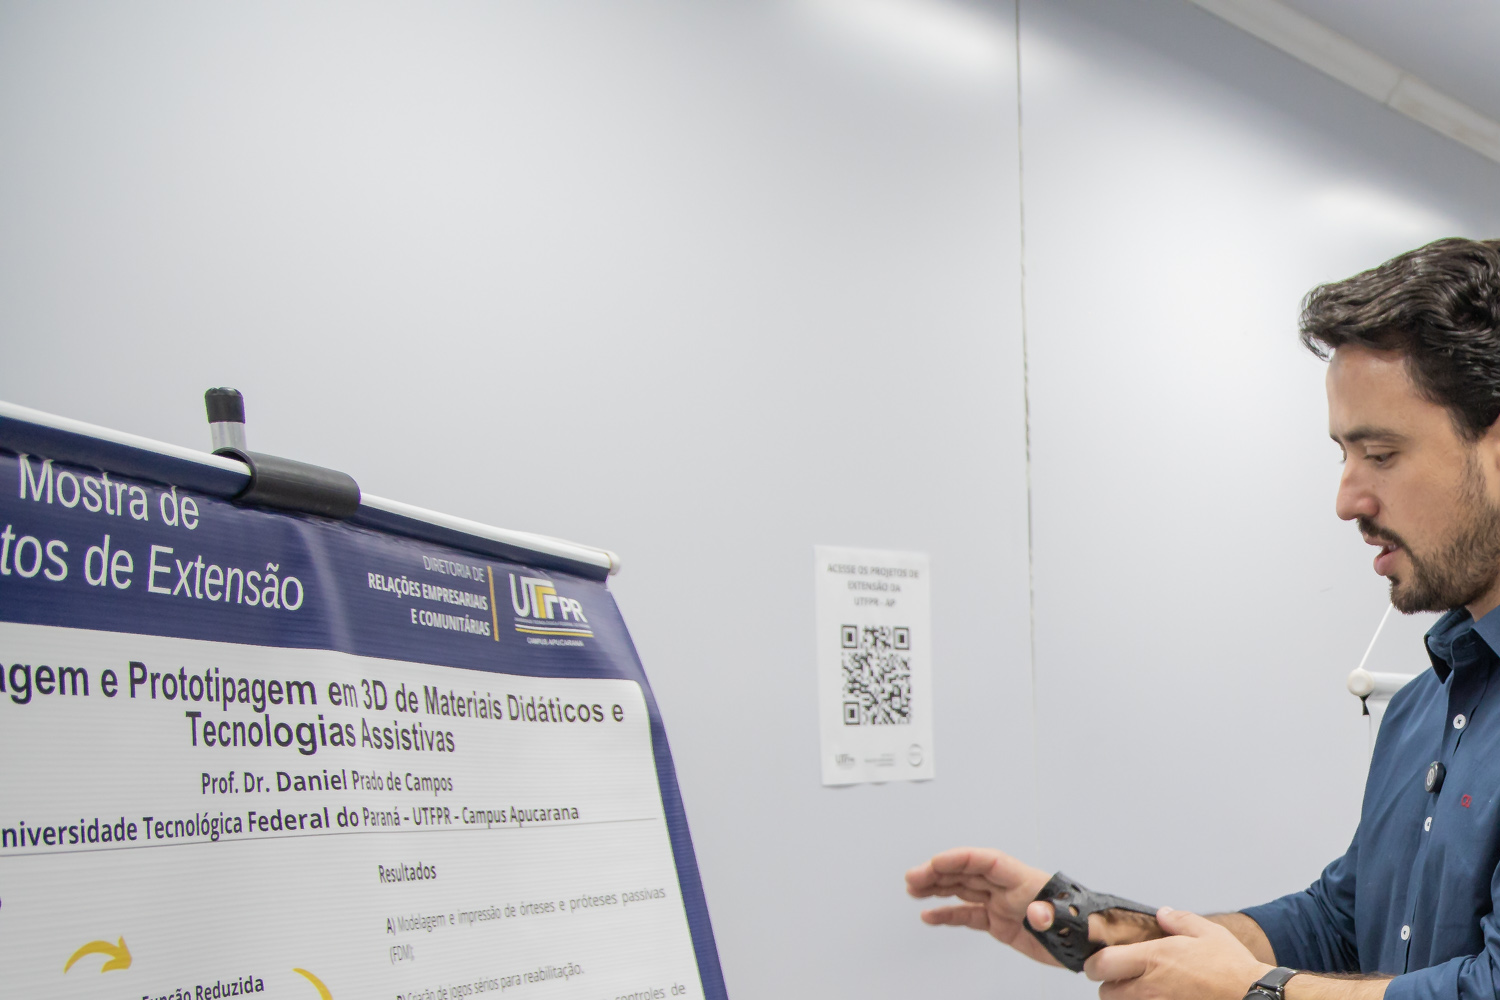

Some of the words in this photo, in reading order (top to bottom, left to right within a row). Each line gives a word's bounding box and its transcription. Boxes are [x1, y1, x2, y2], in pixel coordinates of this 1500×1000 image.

[19, 453, 149, 522] Mostra
[160, 485, 200, 530] de
[84, 534, 134, 590] de
[147, 544, 304, 611] Extensão
[423, 555, 473, 580] DIRETORIA
[472, 566, 486, 583] DE
[827, 563, 857, 575] ACESSE
[857, 565, 869, 576] OS
[869, 566, 908, 579] PROJETOS
[847, 579, 889, 593] EXTENSÃO
[367, 572, 421, 599] RELAÇÕES
[421, 583, 489, 611] EMPRESARIAIS
[508, 573, 589, 623] UTFPR
[410, 608, 418, 625] E
[419, 609, 491, 637] COMUNITÁRIAS
[101, 668, 119, 698] e
[128, 661, 318, 713] Prototipagem
[328, 681, 359, 709] em
[361, 678, 388, 712] 3D
[395, 683, 419, 714] de
[423, 684, 504, 721] Materiais
[506, 693, 605, 724] Didáticos
[612, 702, 625, 723] e
[185, 710, 356, 756] Tecnologias
[361, 717, 456, 753] Assistivas
[201, 771, 239, 795] Prof.
[243, 771, 271, 794] Dr.
[276, 768, 347, 793] Daniel
[351, 769, 384, 792] Prado
[386, 771, 402, 792] de
[405, 772, 454, 797] Campos
[143, 811, 243, 842] Tecnológica
[247, 806, 330, 833] Federal
[337, 806, 360, 828] do
[361, 804, 401, 827] Paraná
[412, 806, 453, 827] UTFPR
[462, 806, 507, 829] Campus
[509, 804, 580, 829] Apucarana
[378, 861, 438, 884] Resultados
[396, 911, 446, 933] Modelagem
[457, 904, 502, 928] impressão
[519, 899, 556, 916] órteses
[568, 891, 618, 915] próteses
[621, 886, 667, 907] passivas
[474, 974, 500, 994] sérios
[499, 973, 522, 991] para
[523, 960, 585, 985] reabilitação.
[670, 981, 687, 997] de
